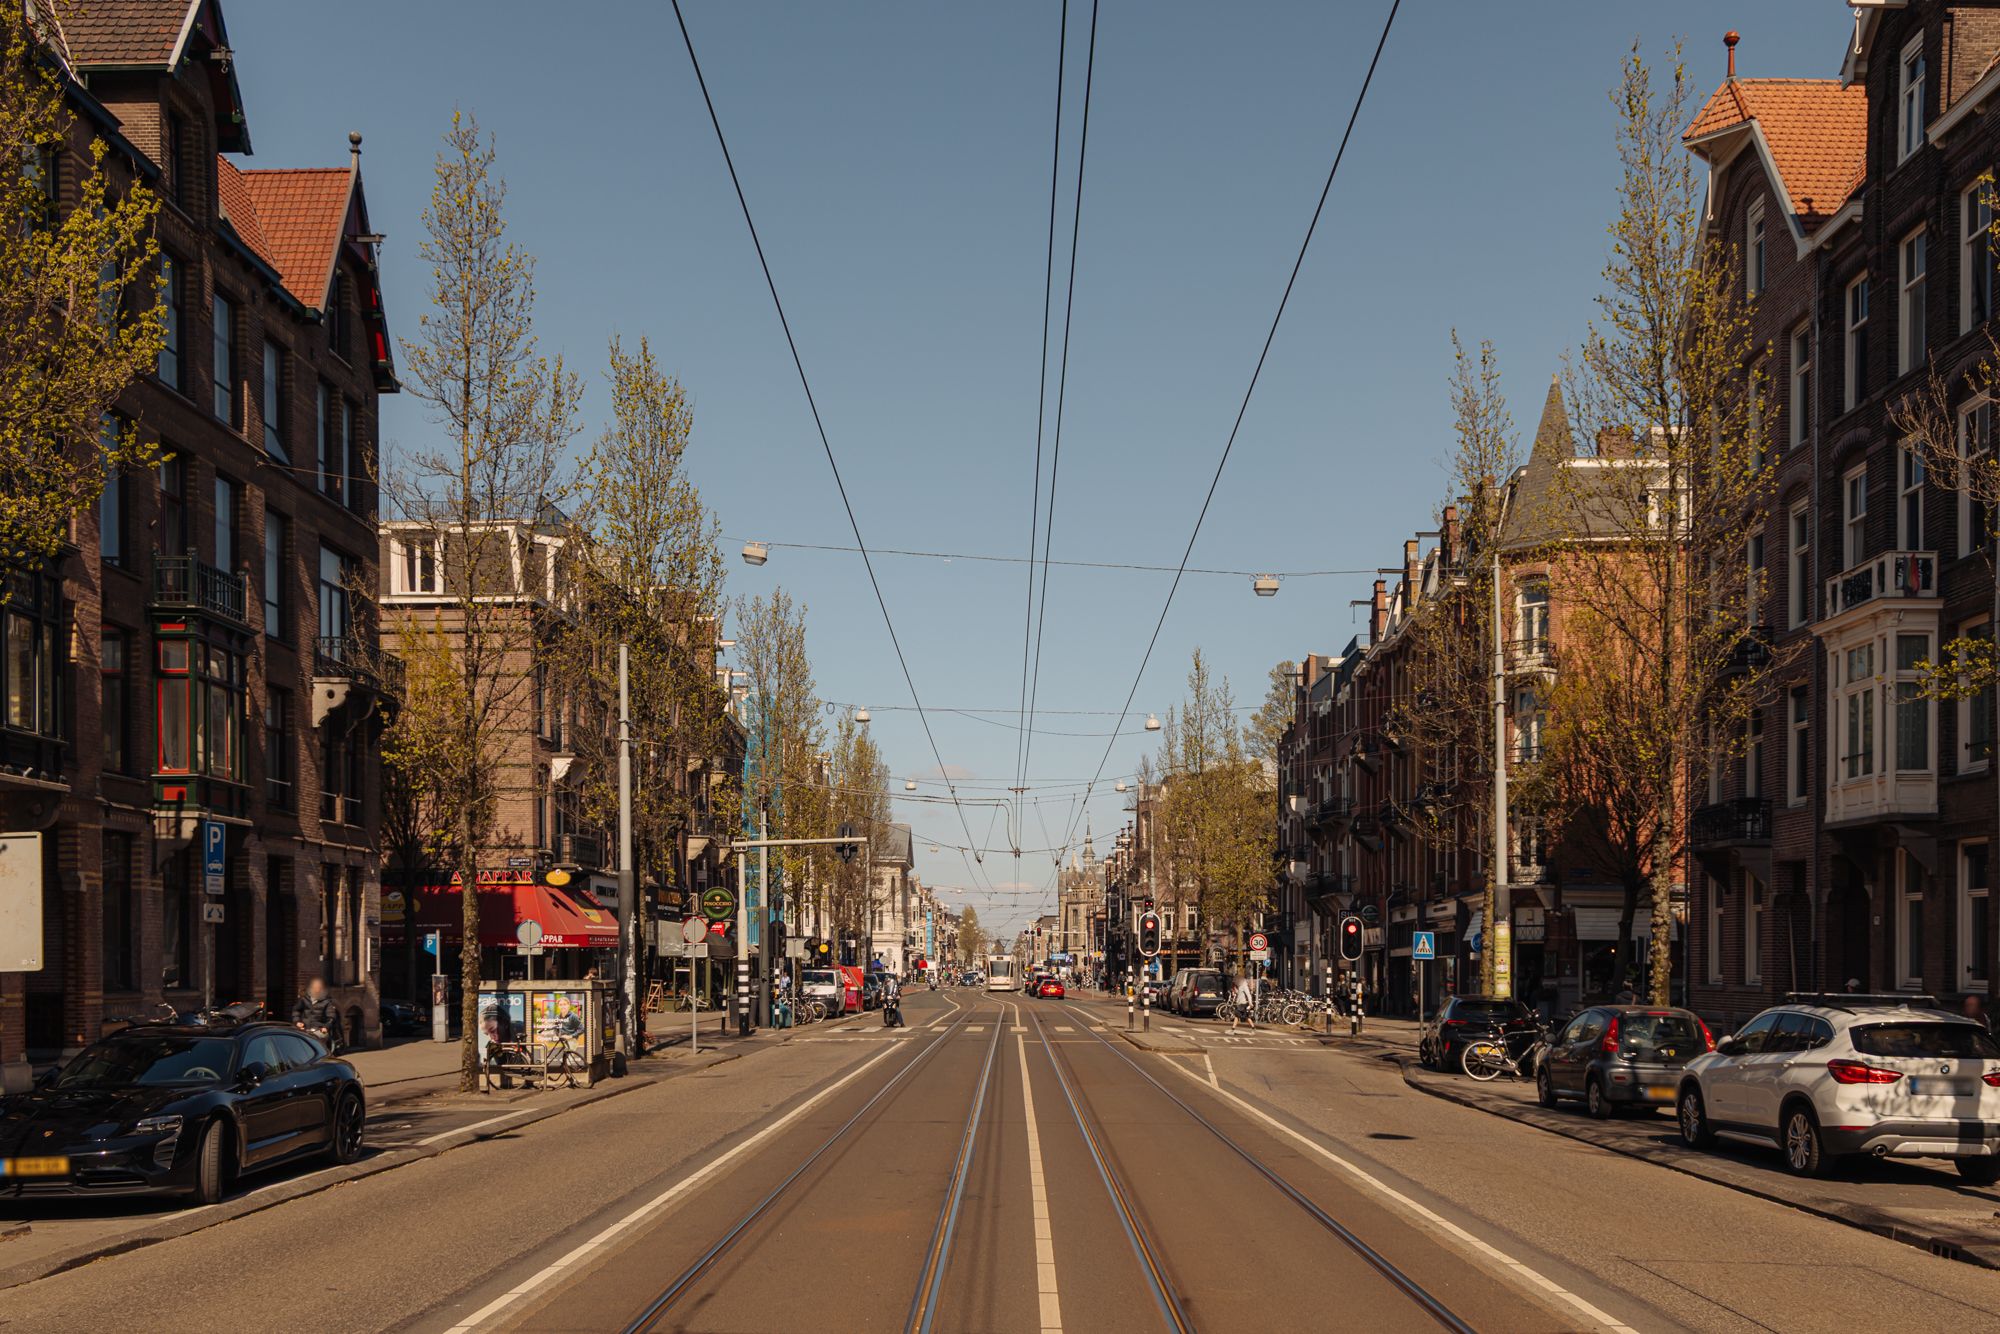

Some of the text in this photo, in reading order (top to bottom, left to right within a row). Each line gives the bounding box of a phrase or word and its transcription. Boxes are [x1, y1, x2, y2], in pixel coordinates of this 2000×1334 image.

[209, 826, 221, 852] P
[426, 939, 433, 949] P
[1253, 939, 1264, 947] 30
